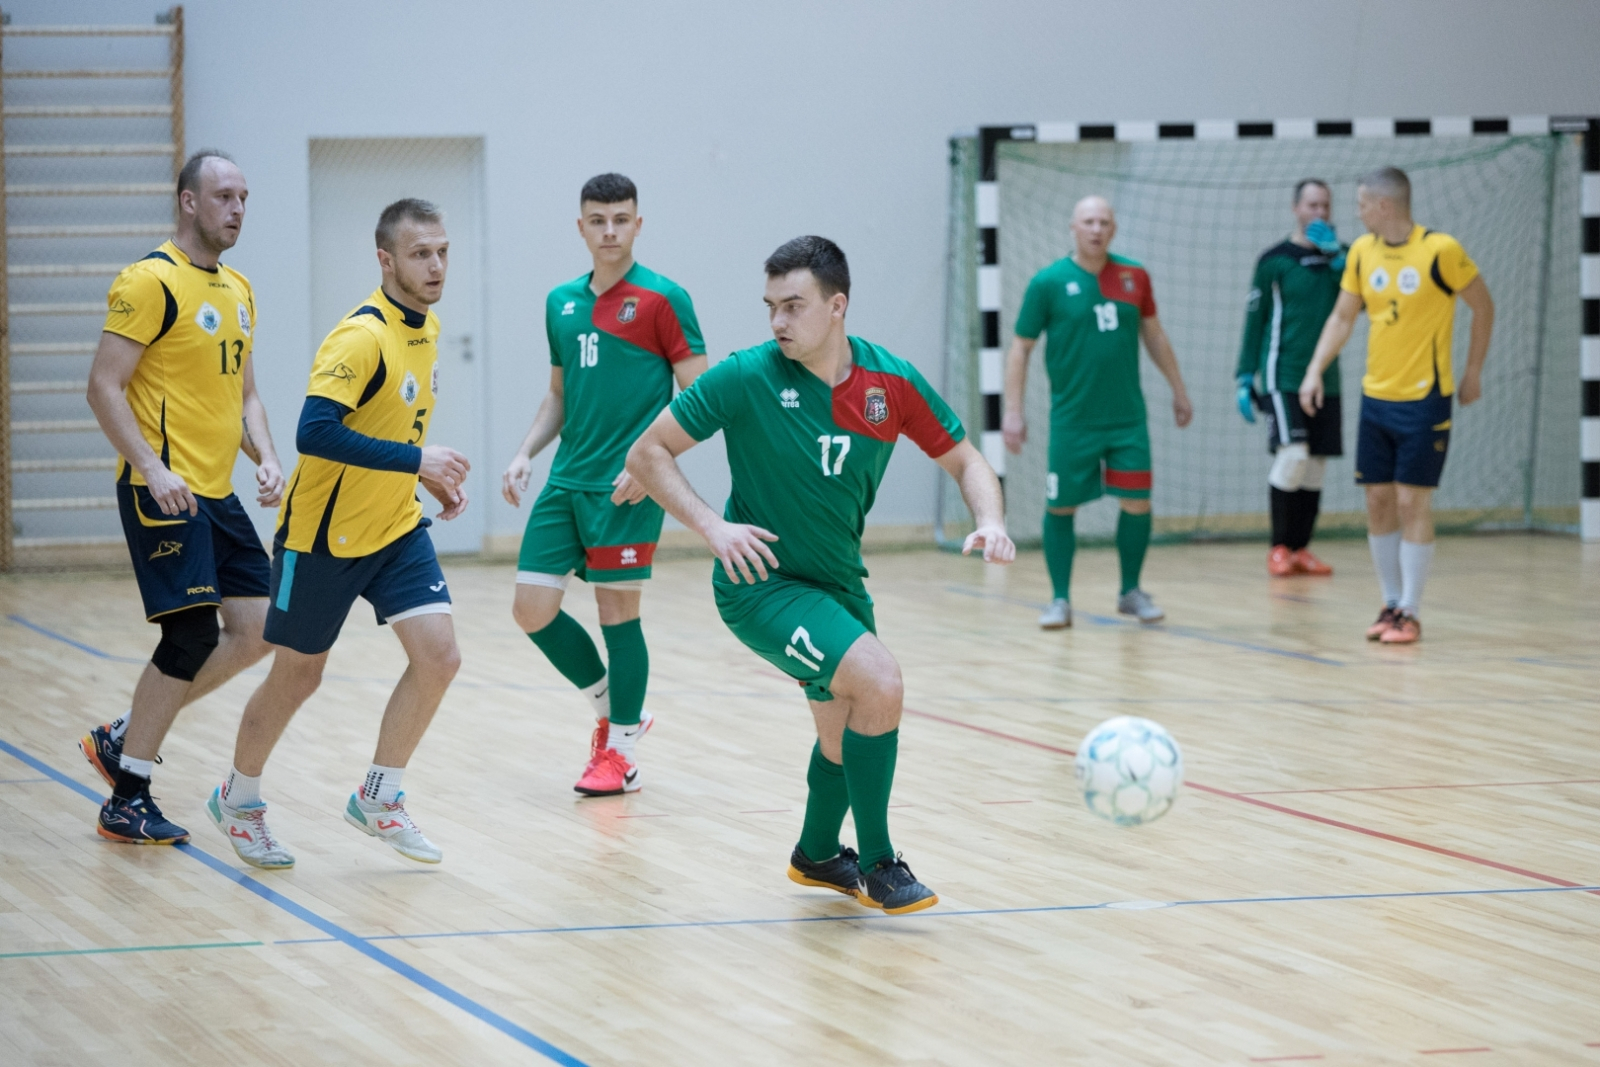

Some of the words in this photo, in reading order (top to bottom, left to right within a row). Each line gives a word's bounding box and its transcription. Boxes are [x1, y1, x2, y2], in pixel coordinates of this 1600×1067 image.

[1093, 302, 1119, 332] 19
[1385, 299, 1399, 326] 3
[218, 339, 244, 375] 13
[577, 332, 599, 368] 16
[408, 408, 427, 445] 5
[817, 435, 851, 476] 17
[785, 626, 825, 672] 17
